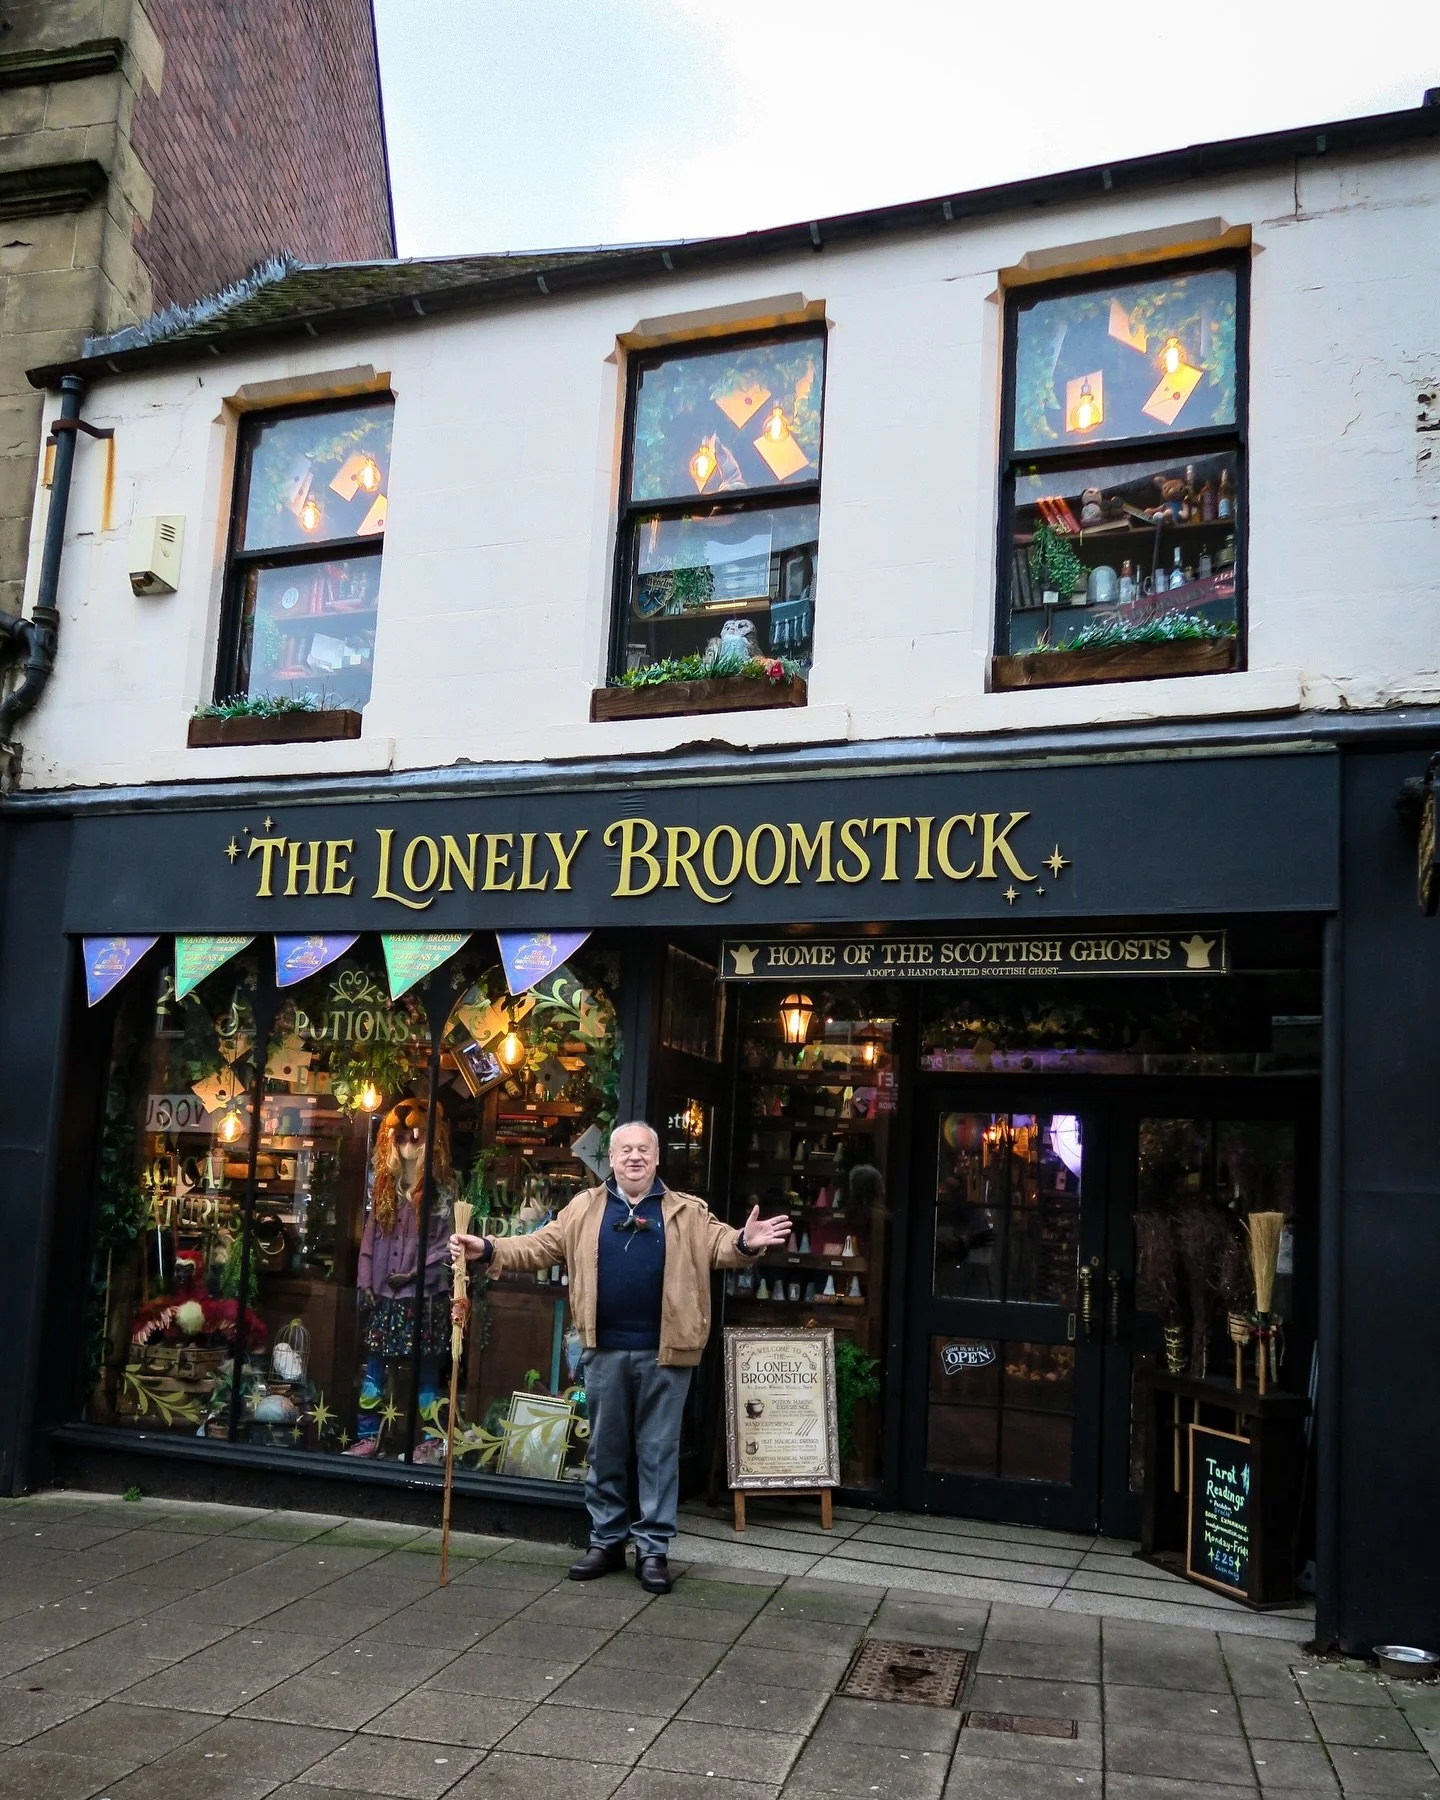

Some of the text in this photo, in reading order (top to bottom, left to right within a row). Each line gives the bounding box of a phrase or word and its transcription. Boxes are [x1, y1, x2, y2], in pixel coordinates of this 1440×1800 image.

[247, 812, 1038, 909] THE LONELY BROOMSTICK
[216, 936, 247, 944] BROOMS
[427, 934, 462, 942] BROOMS
[767, 939, 1171, 966] HOME OF THE SCOTTISH GHOSTS
[866, 966, 1059, 977] ADOPT A HANDCRAFTED SCOTTISH GHOST
[295, 1009, 410, 1042] POTIONS
[756, 1346, 790, 1354] WELCOME
[947, 1349, 990, 1364] OPEN
[756, 1362, 802, 1372] LONELY
[741, 1373, 818, 1384] BROOMSTICK
[1205, 1457, 1238, 1485] Tarot
[1206, 1479, 1245, 1512] Readings
[1204, 1530, 1249, 1558] Monday-Frida
